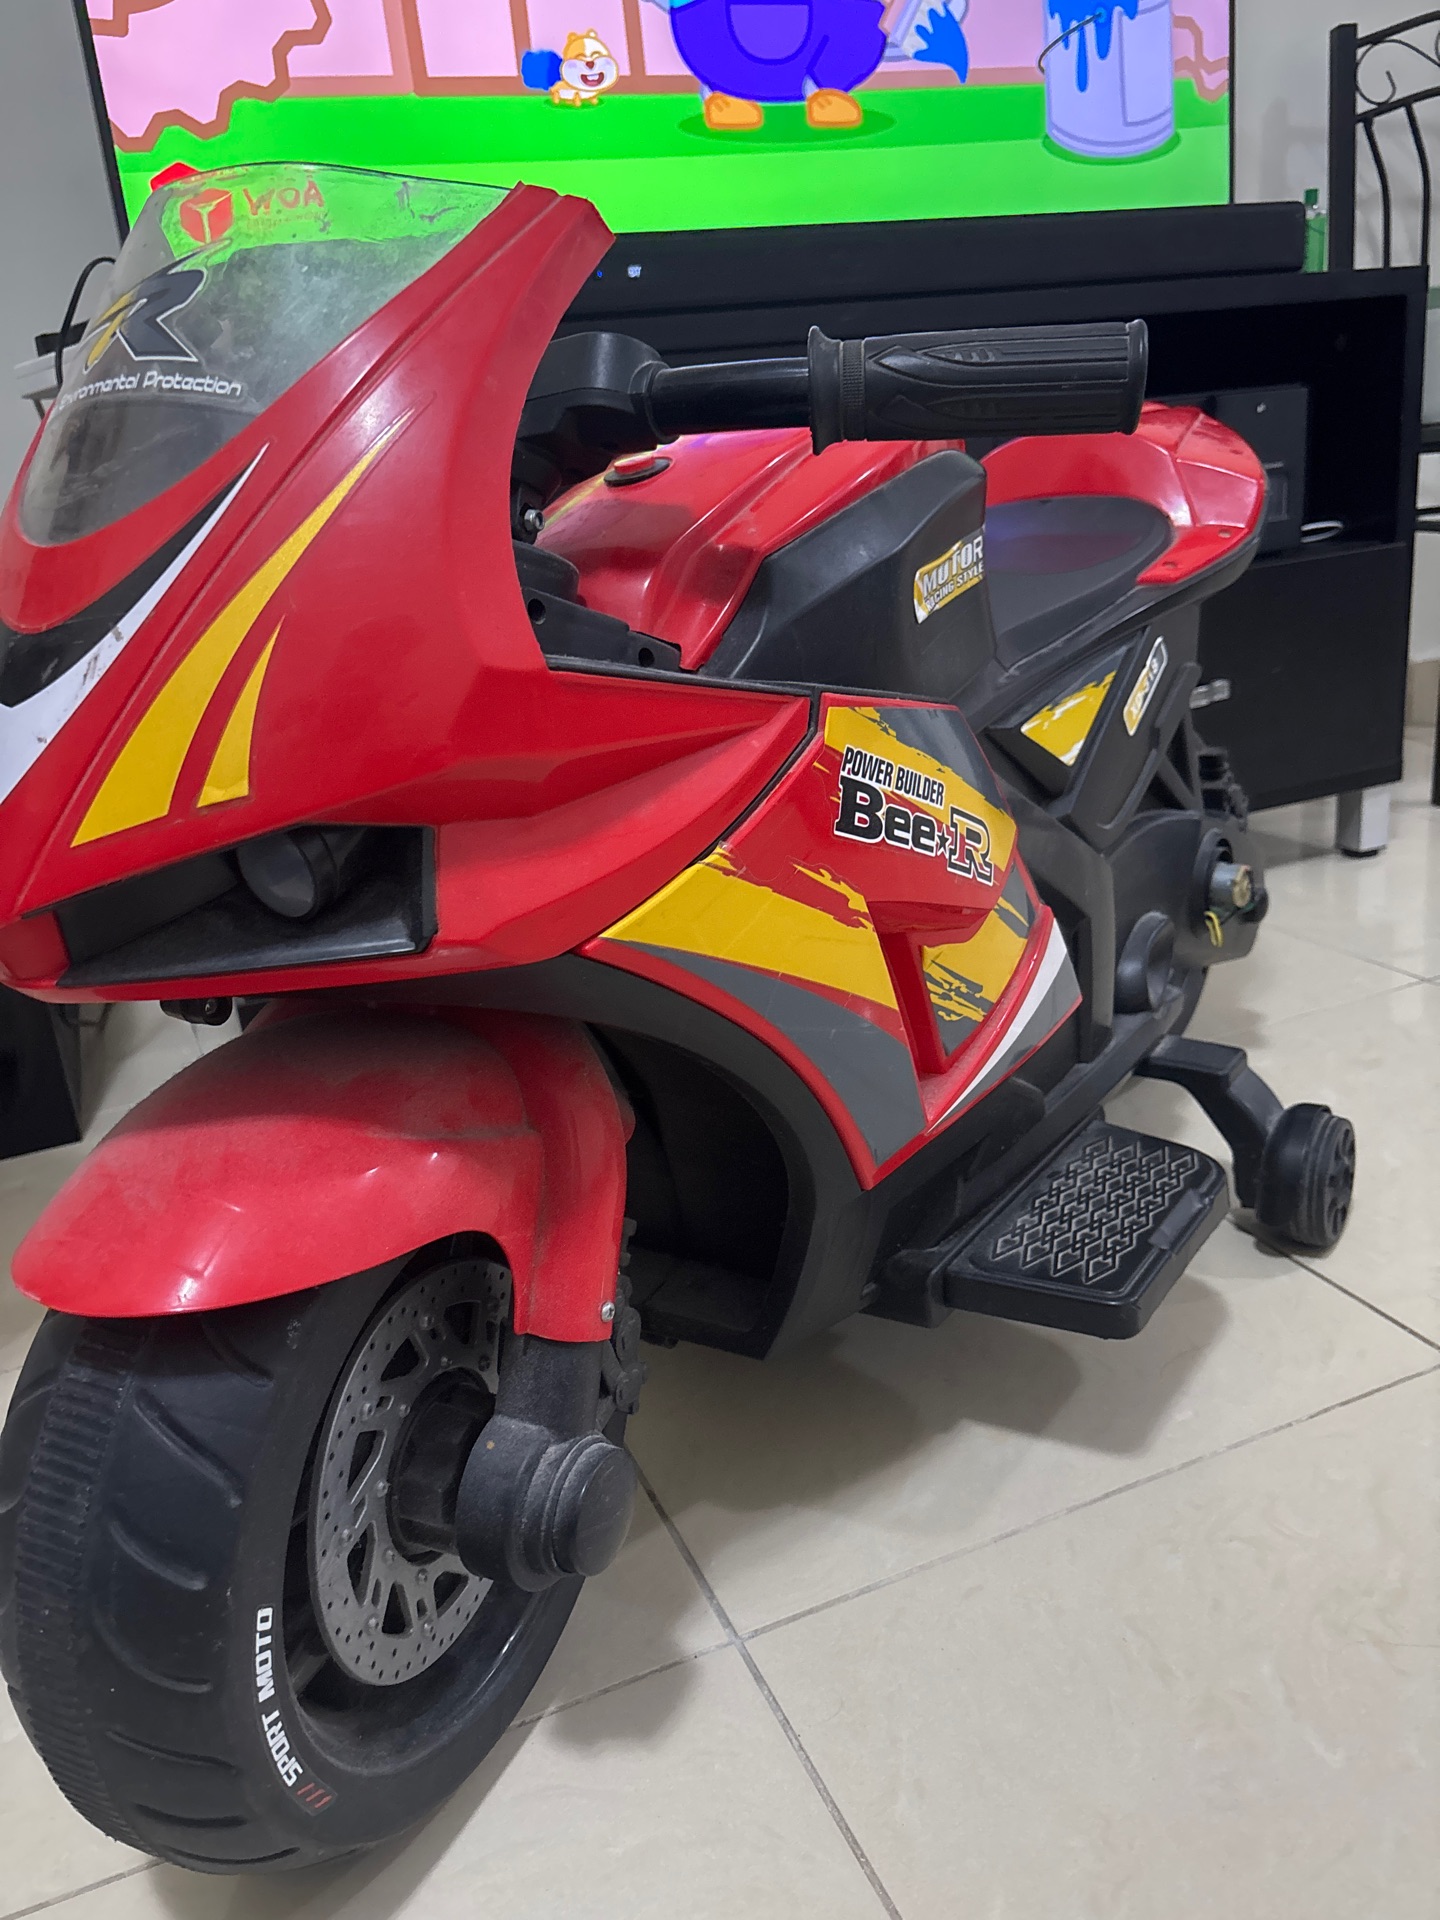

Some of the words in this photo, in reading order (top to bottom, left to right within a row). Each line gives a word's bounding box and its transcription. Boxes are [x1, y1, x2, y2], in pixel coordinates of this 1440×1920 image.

[142, 370, 242, 396] Protection
[922, 536, 984, 597] MOTOR
[924, 581, 954, 612] RACING
[956, 561, 984, 588] STYLE
[841, 745, 894, 788] POWER
[894, 765, 945, 807] BUILDER
[255, 1606, 276, 1704] MOTO
[261, 1709, 304, 1788] SPORT
